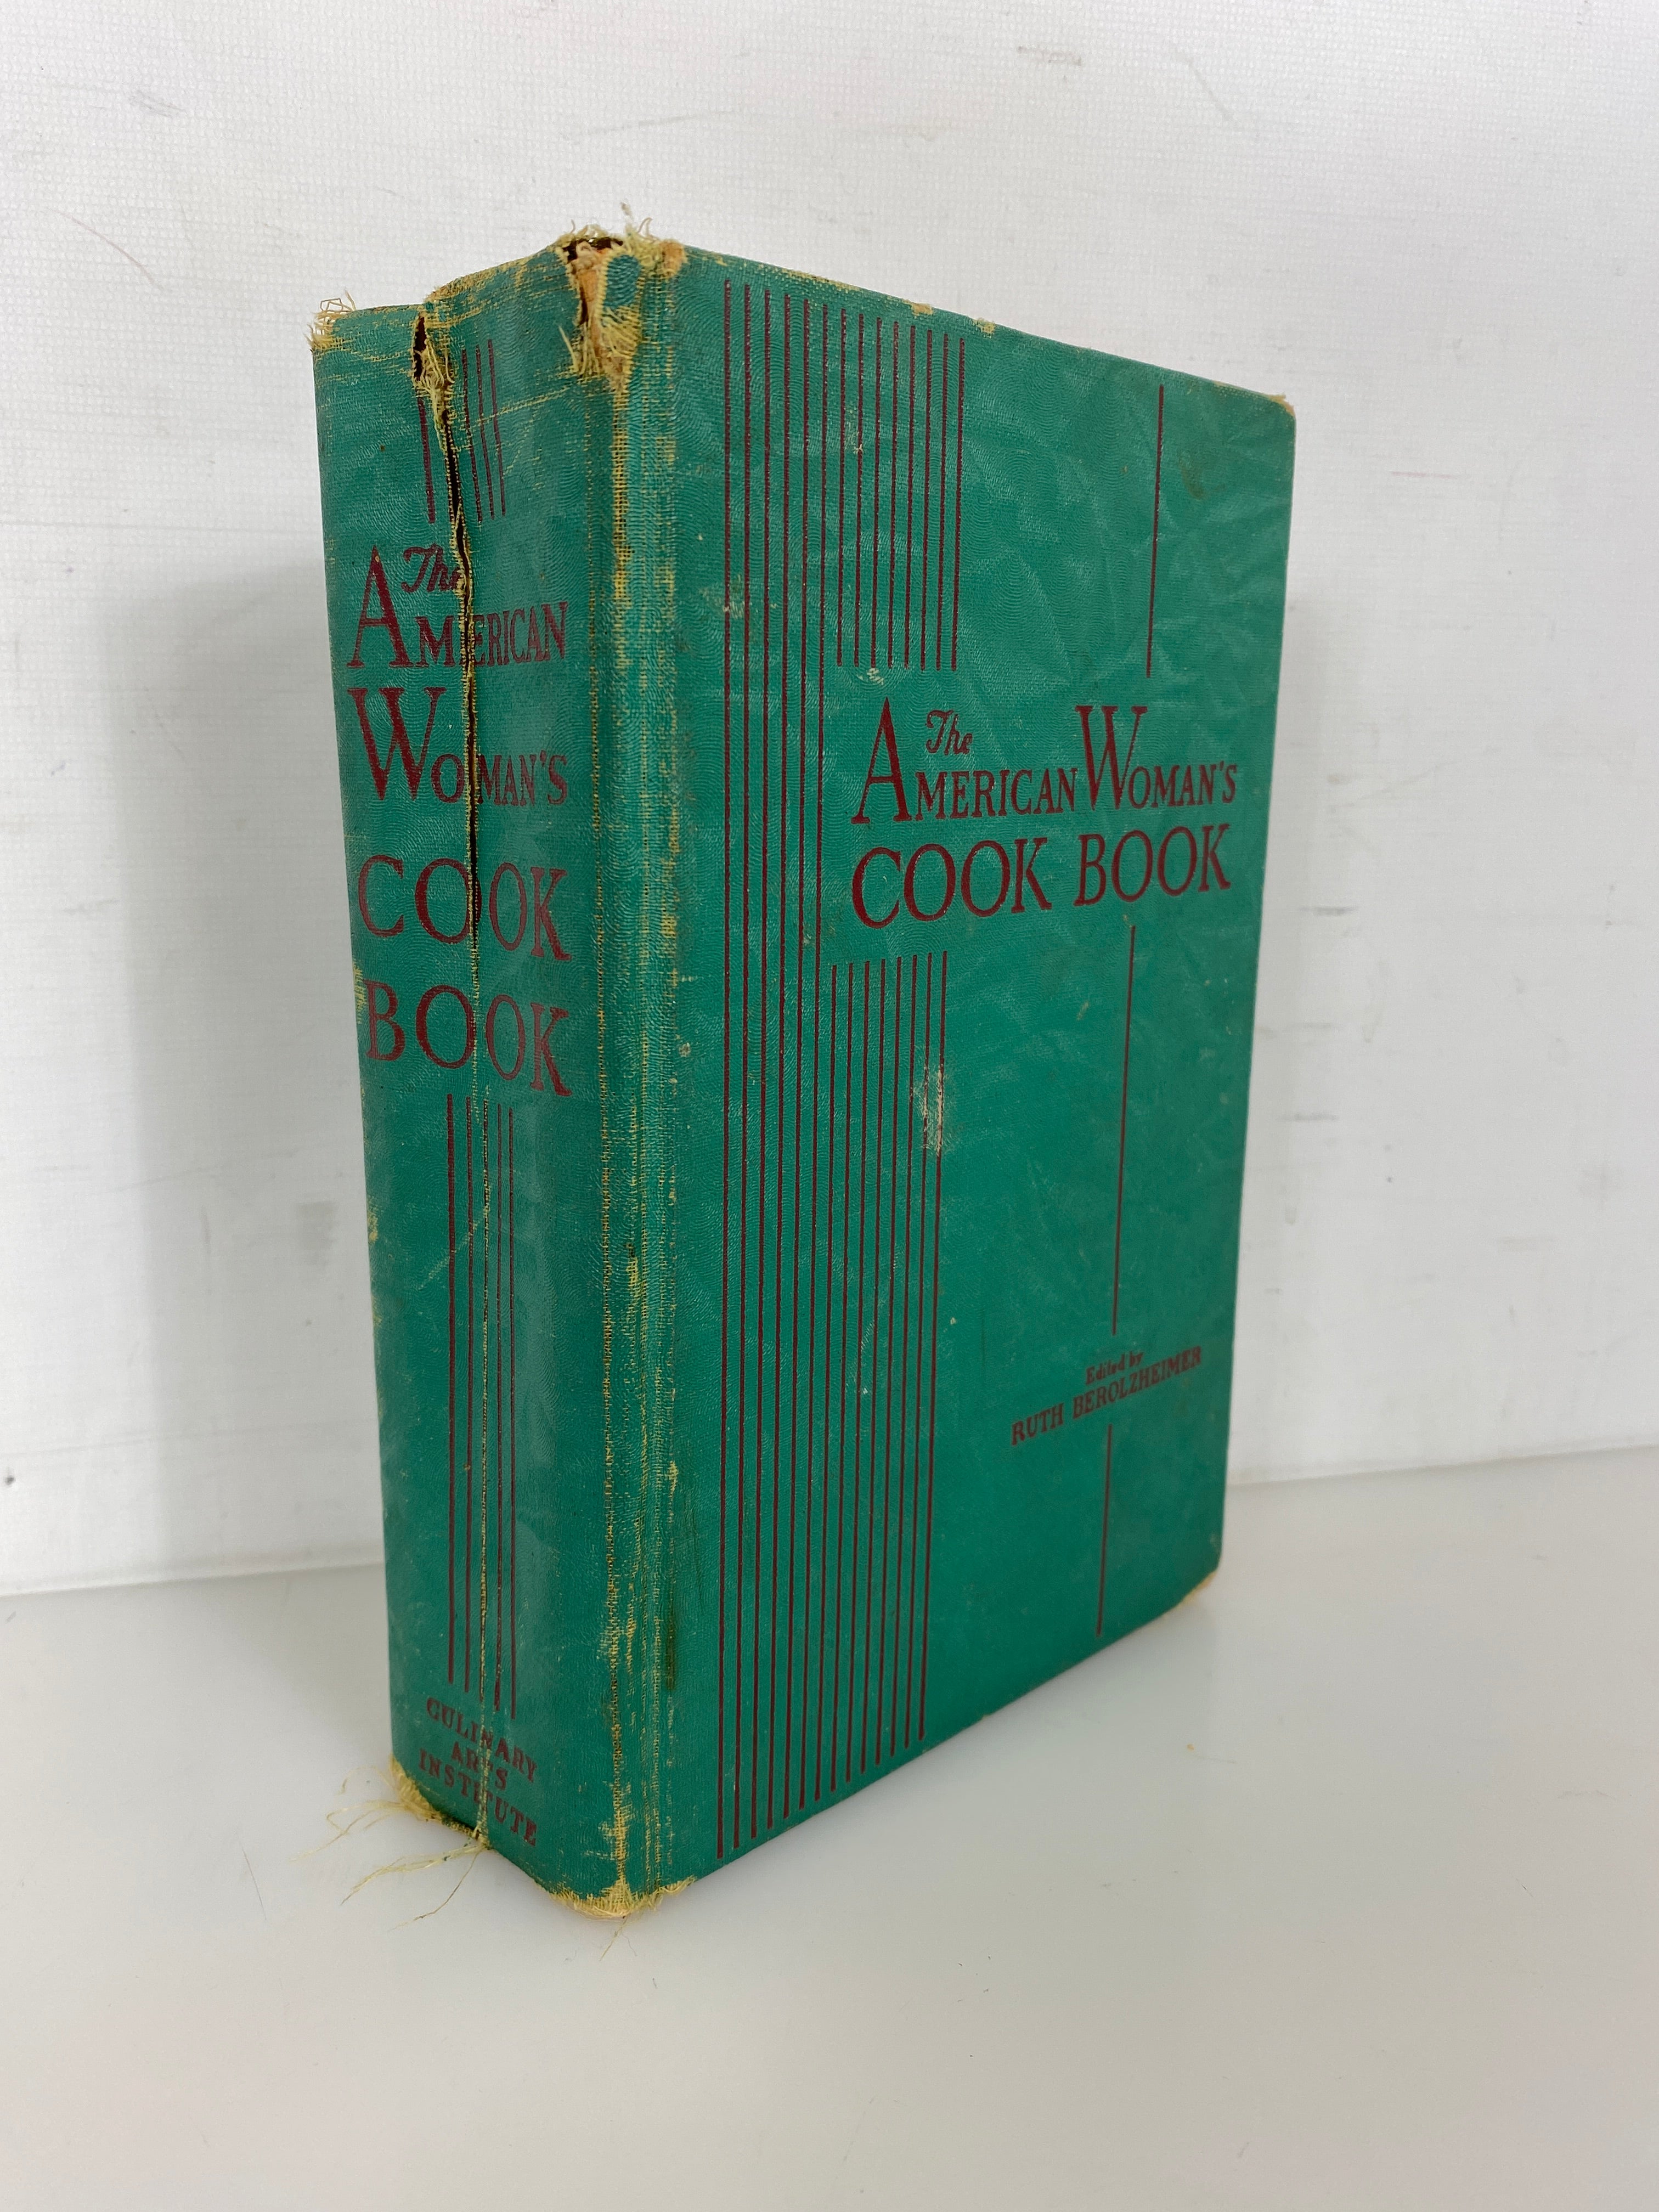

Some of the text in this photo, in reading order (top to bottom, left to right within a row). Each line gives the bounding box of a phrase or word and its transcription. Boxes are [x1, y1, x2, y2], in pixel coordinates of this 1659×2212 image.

[347, 545, 568, 668] AMERICAN
[347, 687, 567, 807] WOMAN'S
[851, 697, 1238, 824] AMERICAN WOMAN'S
[926, 709, 973, 755] The
[358, 855, 572, 960] COOK
[851, 823, 1231, 929] COOK BOOK
[362, 979, 572, 1096] BOOK
[1011, 1345, 1201, 1447] RUTH BEROLZHEIMER
[1086, 1350, 1144, 1386] Edited by
[426, 1697, 538, 1783] CULINARY
